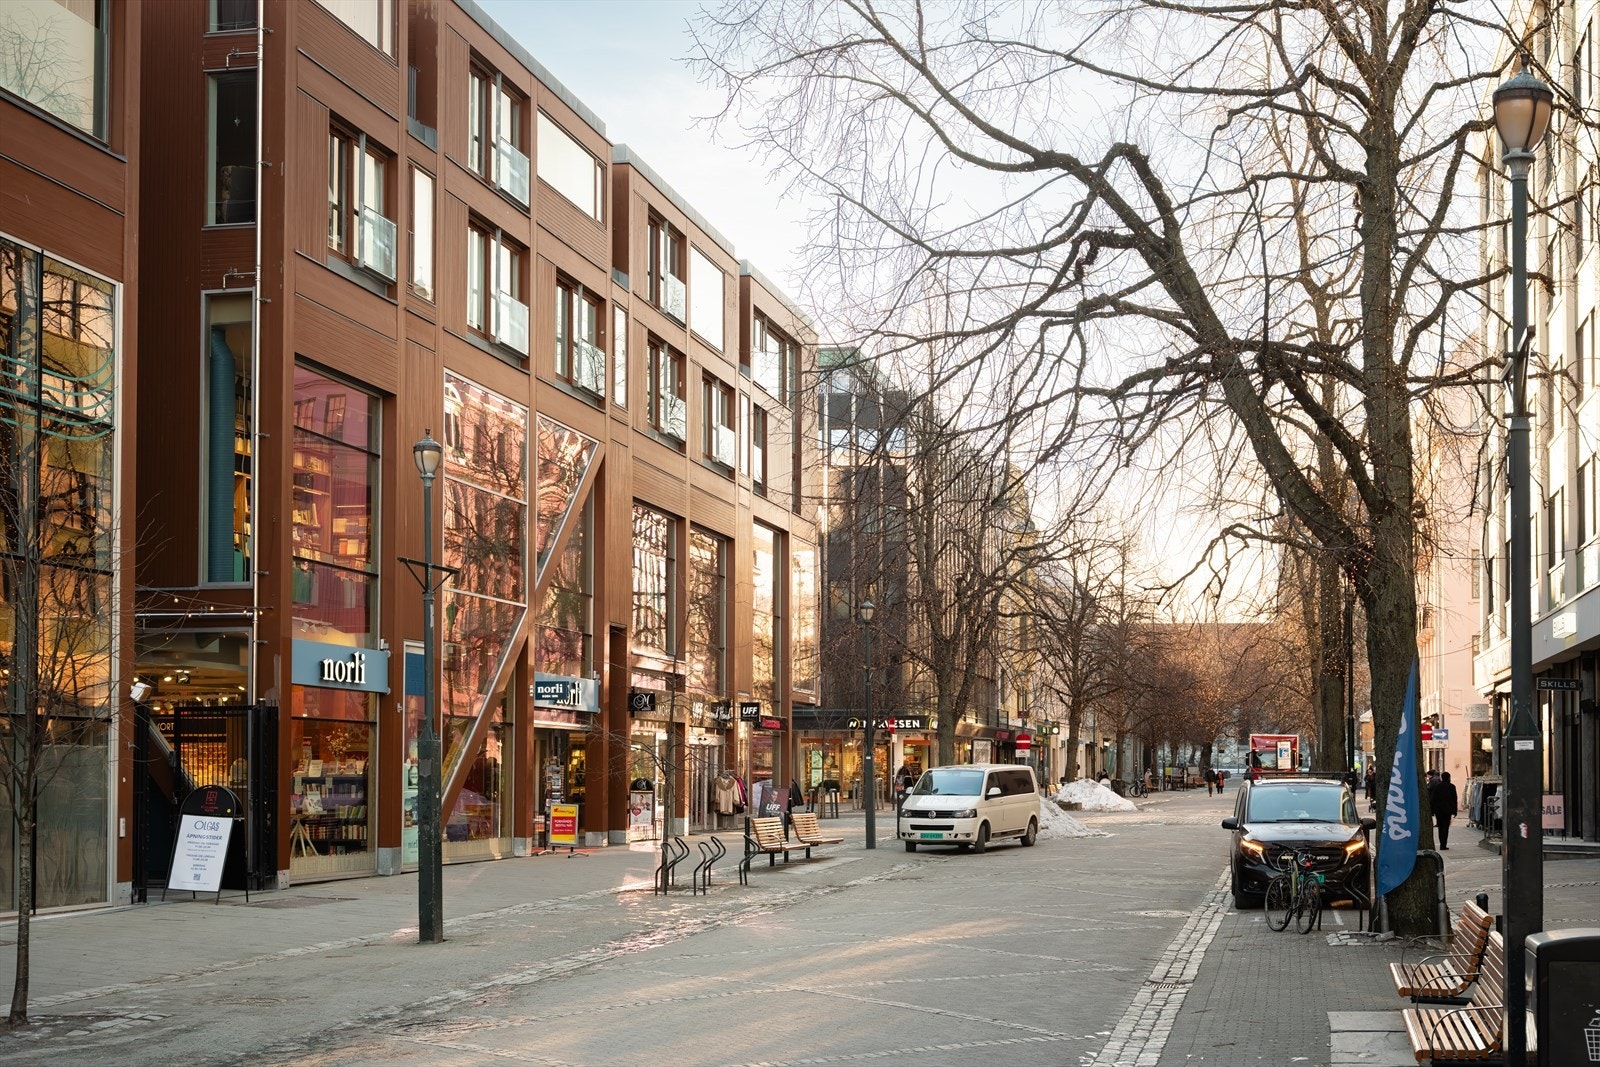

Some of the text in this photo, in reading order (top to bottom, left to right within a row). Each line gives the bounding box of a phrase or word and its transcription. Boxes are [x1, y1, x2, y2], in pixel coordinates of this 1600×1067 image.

[323, 651, 366, 684] norli
[537, 683, 563, 693] norli
[1540, 680, 1577, 689] SKILLS
[742, 706, 758, 714] UFF
[766, 803, 781, 811] UFF
[1541, 805, 1562, 815] SALE
[194, 820, 221, 832] OLGAS
